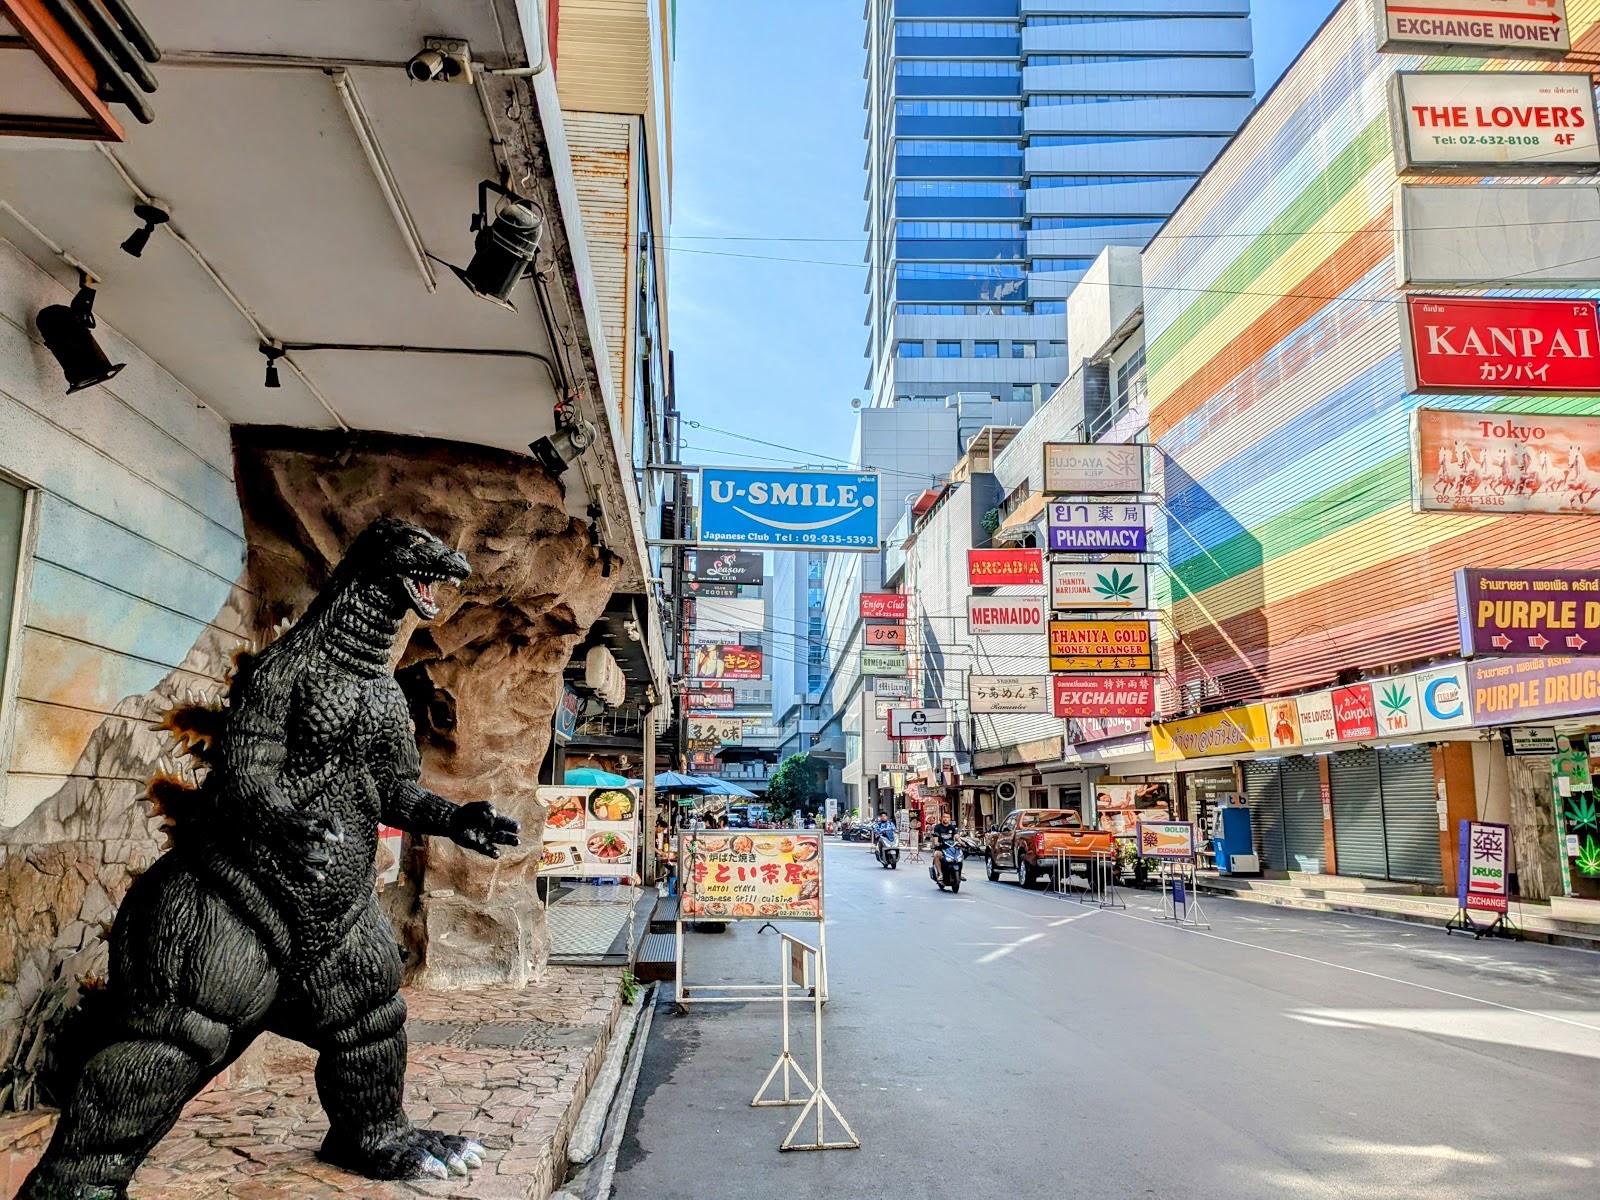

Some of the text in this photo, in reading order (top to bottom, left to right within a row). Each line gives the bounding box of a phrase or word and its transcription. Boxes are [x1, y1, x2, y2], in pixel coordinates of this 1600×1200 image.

[1396, 18, 1561, 43] EXCHANGE MONEY
[1411, 106, 1585, 128] THE LOVERS
[1432, 133, 1576, 146] Tel: 02-632-8108 4F
[1424, 325, 1593, 358] KANPAI
[1478, 420, 1546, 443] Tokyo
[1436, 494, 1505, 506] 02-234-1816
[703, 531, 746, 542] Japanese
[747, 532, 770, 541] Club
[802, 533, 874, 545] 02-235-5393
[1056, 529, 1139, 547] PHARMACY
[971, 560, 1040, 575] ARCADIA
[1058, 578, 1086, 586] THANIYA
[1055, 586, 1091, 594] MARIJUANA
[862, 599, 905, 612] Enjoy Club
[972, 607, 1041, 625] MERMAIDO
[1477, 600, 1577, 629] PURPLE
[1052, 629, 1147, 643] THANIYA GOLD
[1057, 645, 1143, 654] MONEY CHANGER
[1060, 691, 1149, 705] EXCHANGE
[1475, 670, 1600, 714] PURPLE DRUG
[1301, 709, 1333, 724] THE LOVERS
[1334, 702, 1373, 725] Kanpai
[1386, 714, 1409, 730] TMJ
[1325, 729, 1335, 740] 4F
[1472, 866, 1502, 878] DRUGS
[733, 885, 756, 893] CYAYA
[695, 894, 732, 903] Japanese
[735, 894, 757, 903] Grill
[1467, 896, 1506, 908] EXCHANGE
